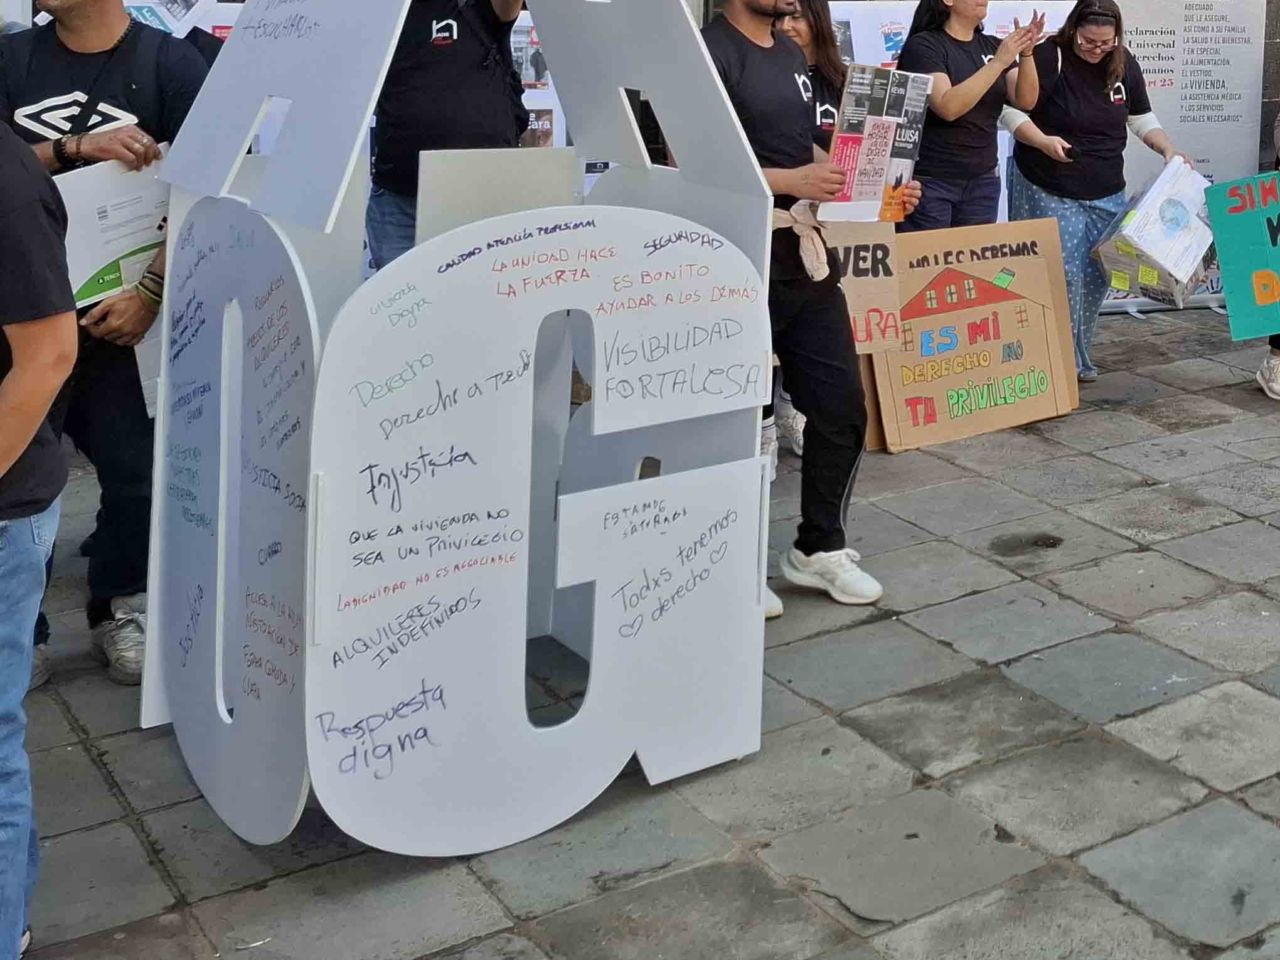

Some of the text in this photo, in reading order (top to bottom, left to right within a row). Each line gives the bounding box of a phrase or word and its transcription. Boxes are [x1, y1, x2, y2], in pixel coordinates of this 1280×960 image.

[1184, 3, 1214, 11] ADECUADO
[1123, 27, 1176, 36] eclaración
[1224, 26, 1246, 34] FAMILIA
[1142, 67, 1175, 75] manos
[1189, 80, 1229, 91] VIVIENDA,
[1179, 115, 1206, 123] SOCIALES
[895, 128, 919, 143] LUISA
[1227, 178, 1280, 214] SIN
[577, 246, 617, 264] HACE
[644, 230, 724, 256] SEGURIDAD
[497, 269, 591, 297] LA FUERZA
[613, 275, 633, 292] ES
[596, 294, 656, 317] AYUDAR
[664, 294, 674, 304] A
[679, 291, 702, 305] LOS
[920, 326, 959, 357] ES
[901, 340, 1024, 387] DERECHO NO
[349, 353, 434, 408] Derecho
[905, 396, 938, 428] TU
[349, 530, 378, 544] QUE
[387, 524, 404, 537] LA
[486, 508, 510, 521] NO
[352, 550, 385, 567] SEA
[398, 545, 420, 559] UN
[415, 571, 430, 585] NO
[436, 566, 450, 579] ES
[651, 568, 711, 622] derecho
[332, 594, 441, 668] ALQUILERES
[372, 587, 482, 670] INDEFINIDOS
[315, 678, 447, 742] Respuesta
[338, 726, 439, 780] digna
